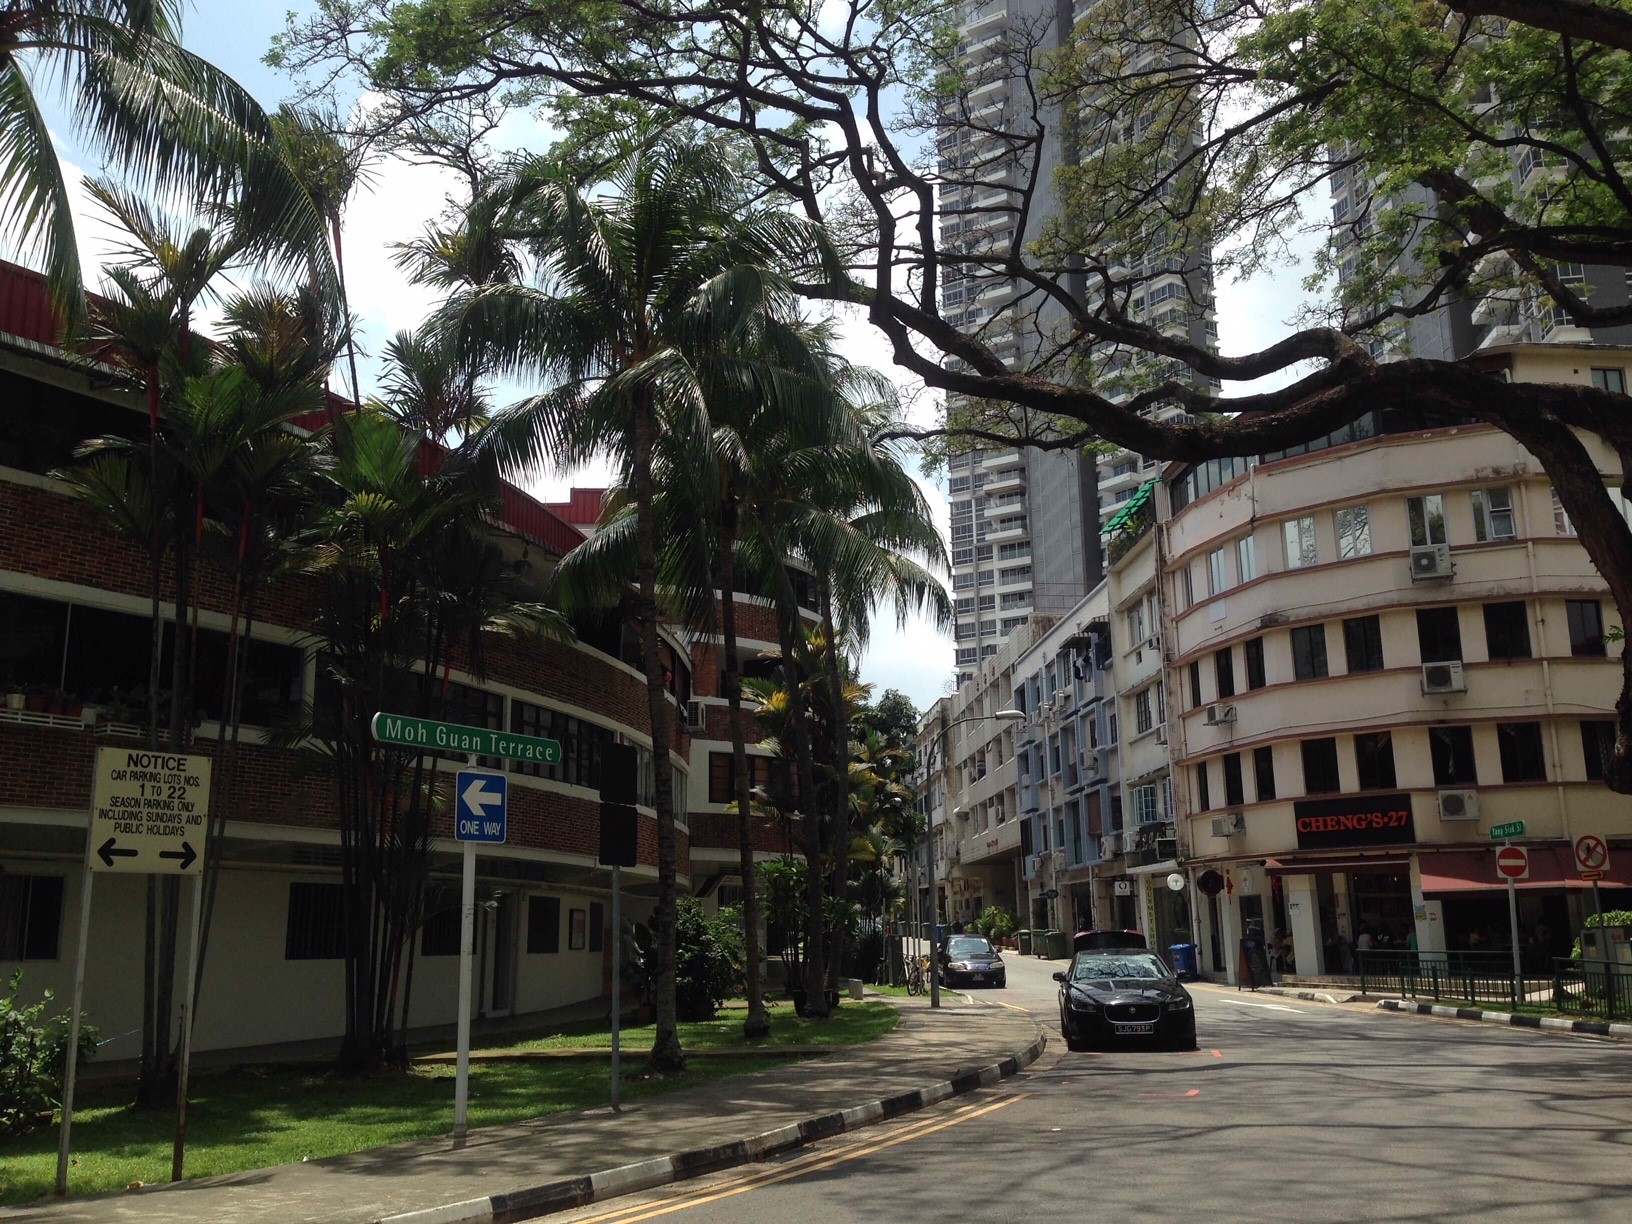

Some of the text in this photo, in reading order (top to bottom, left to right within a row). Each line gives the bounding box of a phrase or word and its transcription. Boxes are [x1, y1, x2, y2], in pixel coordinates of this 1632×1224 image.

[386, 718, 553, 761] Moh Guan Terrace
[127, 753, 188, 772] NOTICE
[110, 769, 200, 787] CAR PARKING LOTS NOS.
[139, 783, 187, 800] 1 TO 22
[110, 796, 195, 813] SEASON PARKING ONLY
[98, 808, 202, 826] INCLUDING SUNDAYS AND
[114, 822, 184, 837] PUBLIC HOLIDAYS
[460, 820, 502, 836] ONE WAY
